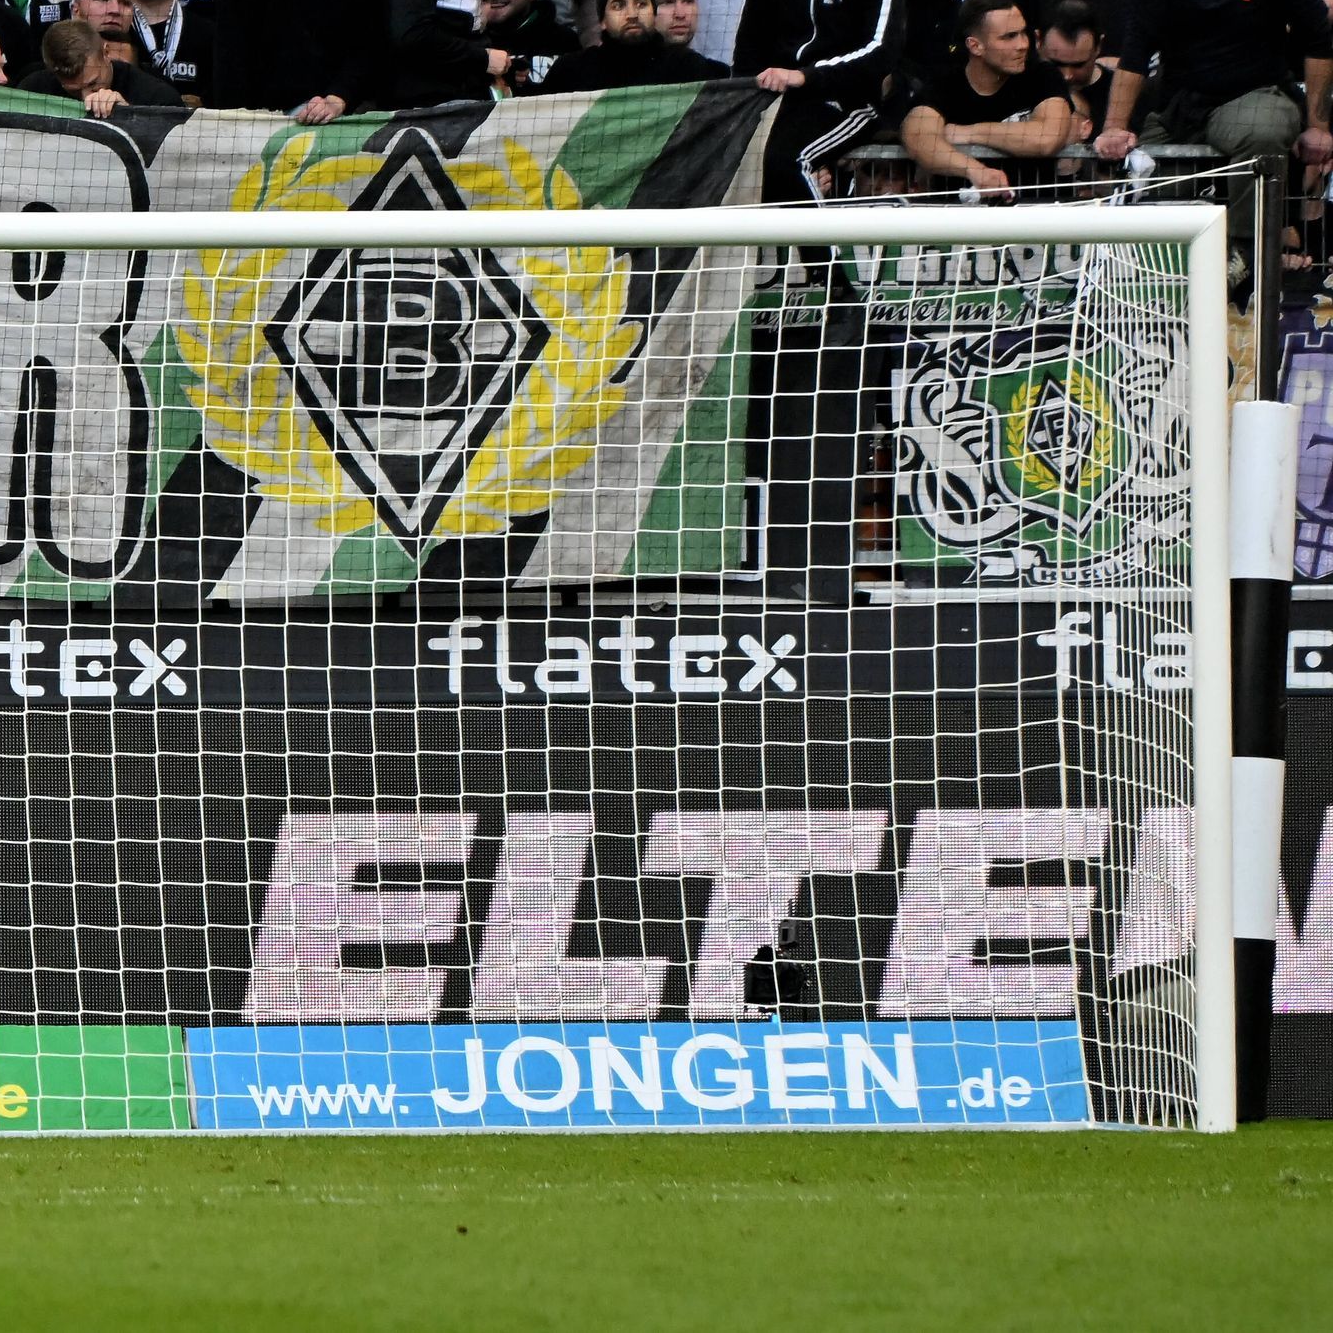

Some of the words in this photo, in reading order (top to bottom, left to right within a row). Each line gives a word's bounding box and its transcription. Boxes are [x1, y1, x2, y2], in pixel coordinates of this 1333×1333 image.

[427, 615, 798, 695] flatex
[248, 1083, 410, 1116] www.
[432, 1032, 918, 1114] JONGEN
[945, 1067, 1032, 1109] .de
